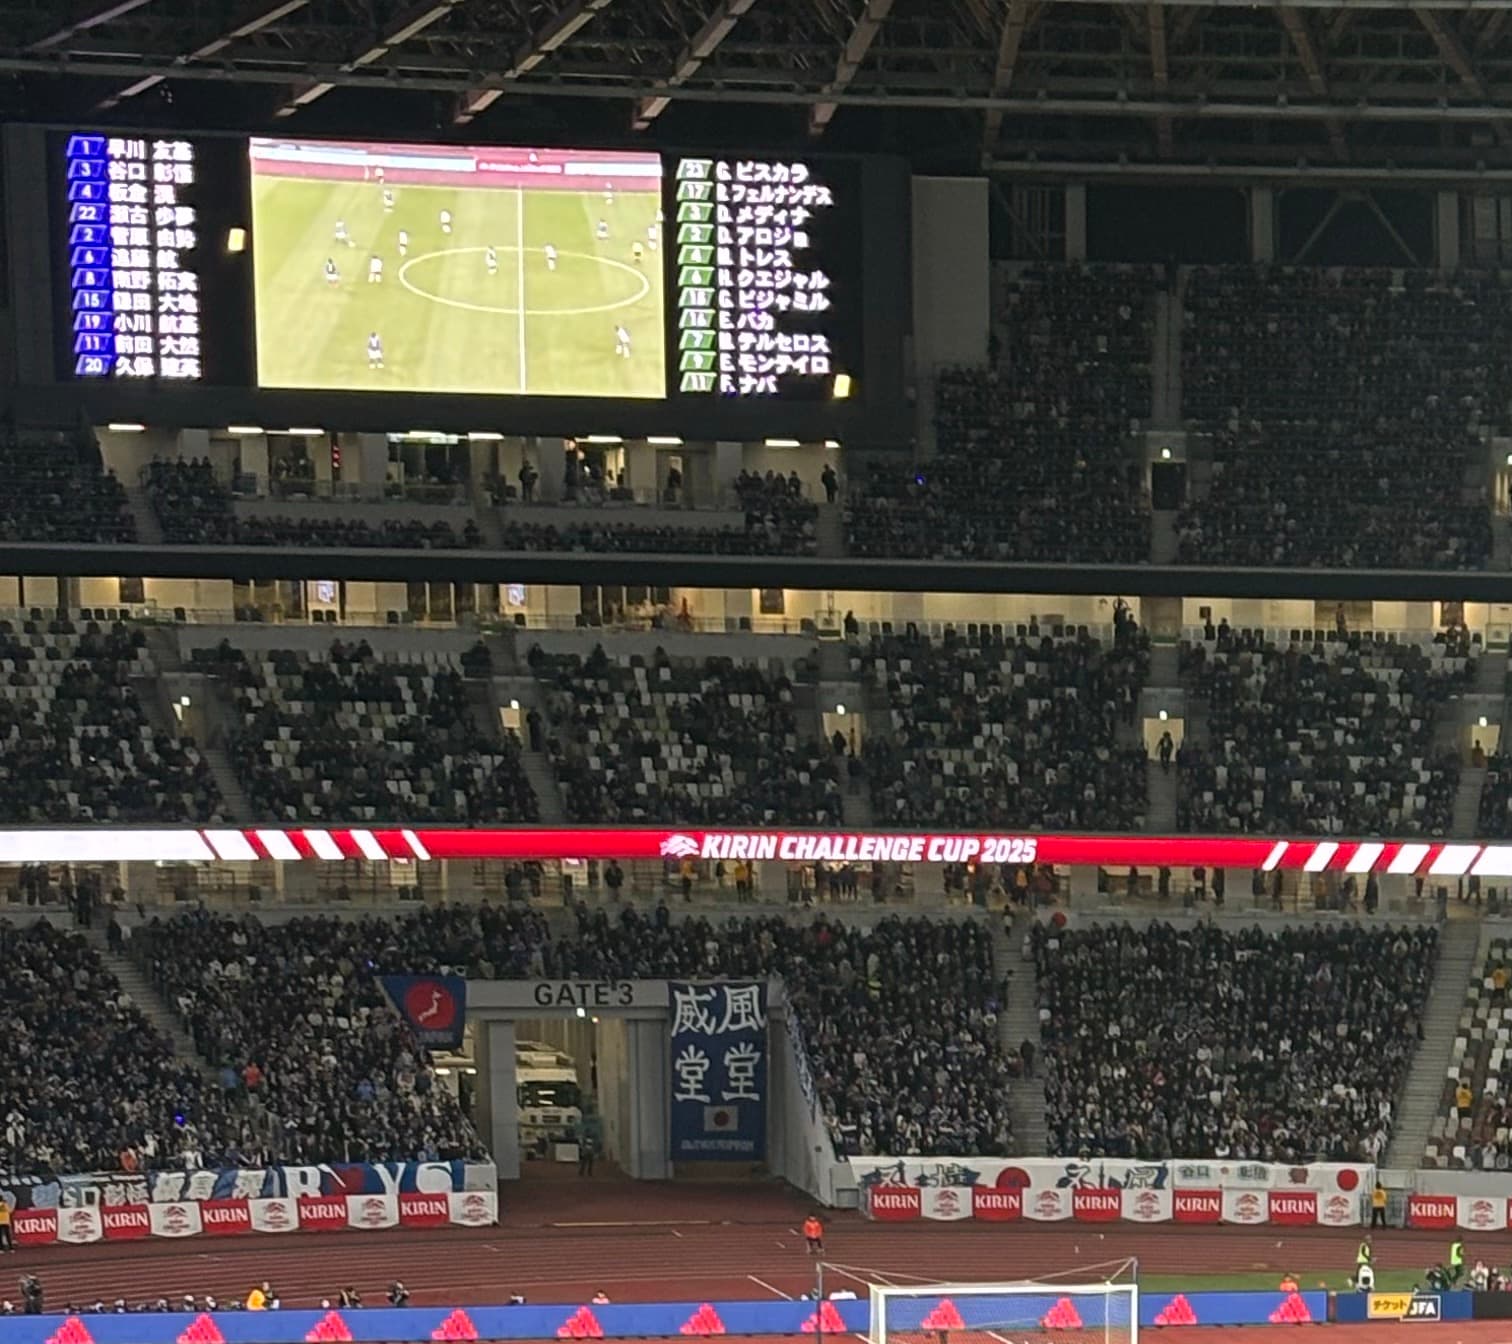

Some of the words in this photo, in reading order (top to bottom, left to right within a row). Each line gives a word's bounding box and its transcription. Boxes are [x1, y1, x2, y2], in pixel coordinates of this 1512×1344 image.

[108, 161, 146, 180] 谷口
[113, 313, 152, 332] 小川
[701, 836, 778, 859] KIRIN
[779, 836, 926, 861] CHALLENGE
[926, 839, 982, 862] CUP
[980, 839, 1037, 863] 2025
[533, 982, 611, 1006] GATE
[619, 983, 633, 1006] 3
[672, 983, 766, 1037] 威風
[401, 1200, 447, 1216] KIRIN
[873, 1194, 919, 1209] KIRIN
[975, 1195, 1021, 1209] KIRIN
[1074, 1195, 1119, 1209] KIRIN
[1175, 1197, 1220, 1212] KIRIN
[1271, 1199, 1315, 1214] KIRIN
[203, 1208, 248, 1223] KIRIN
[301, 1204, 346, 1219] KIRIN
[1411, 1202, 1455, 1217] KIRIN
[14, 1217, 57, 1233] KIRIN
[104, 1212, 148, 1228] KIRIN
[1373, 1300, 1407, 1311] チケット
[1409, 1302, 1437, 1315] JFA
